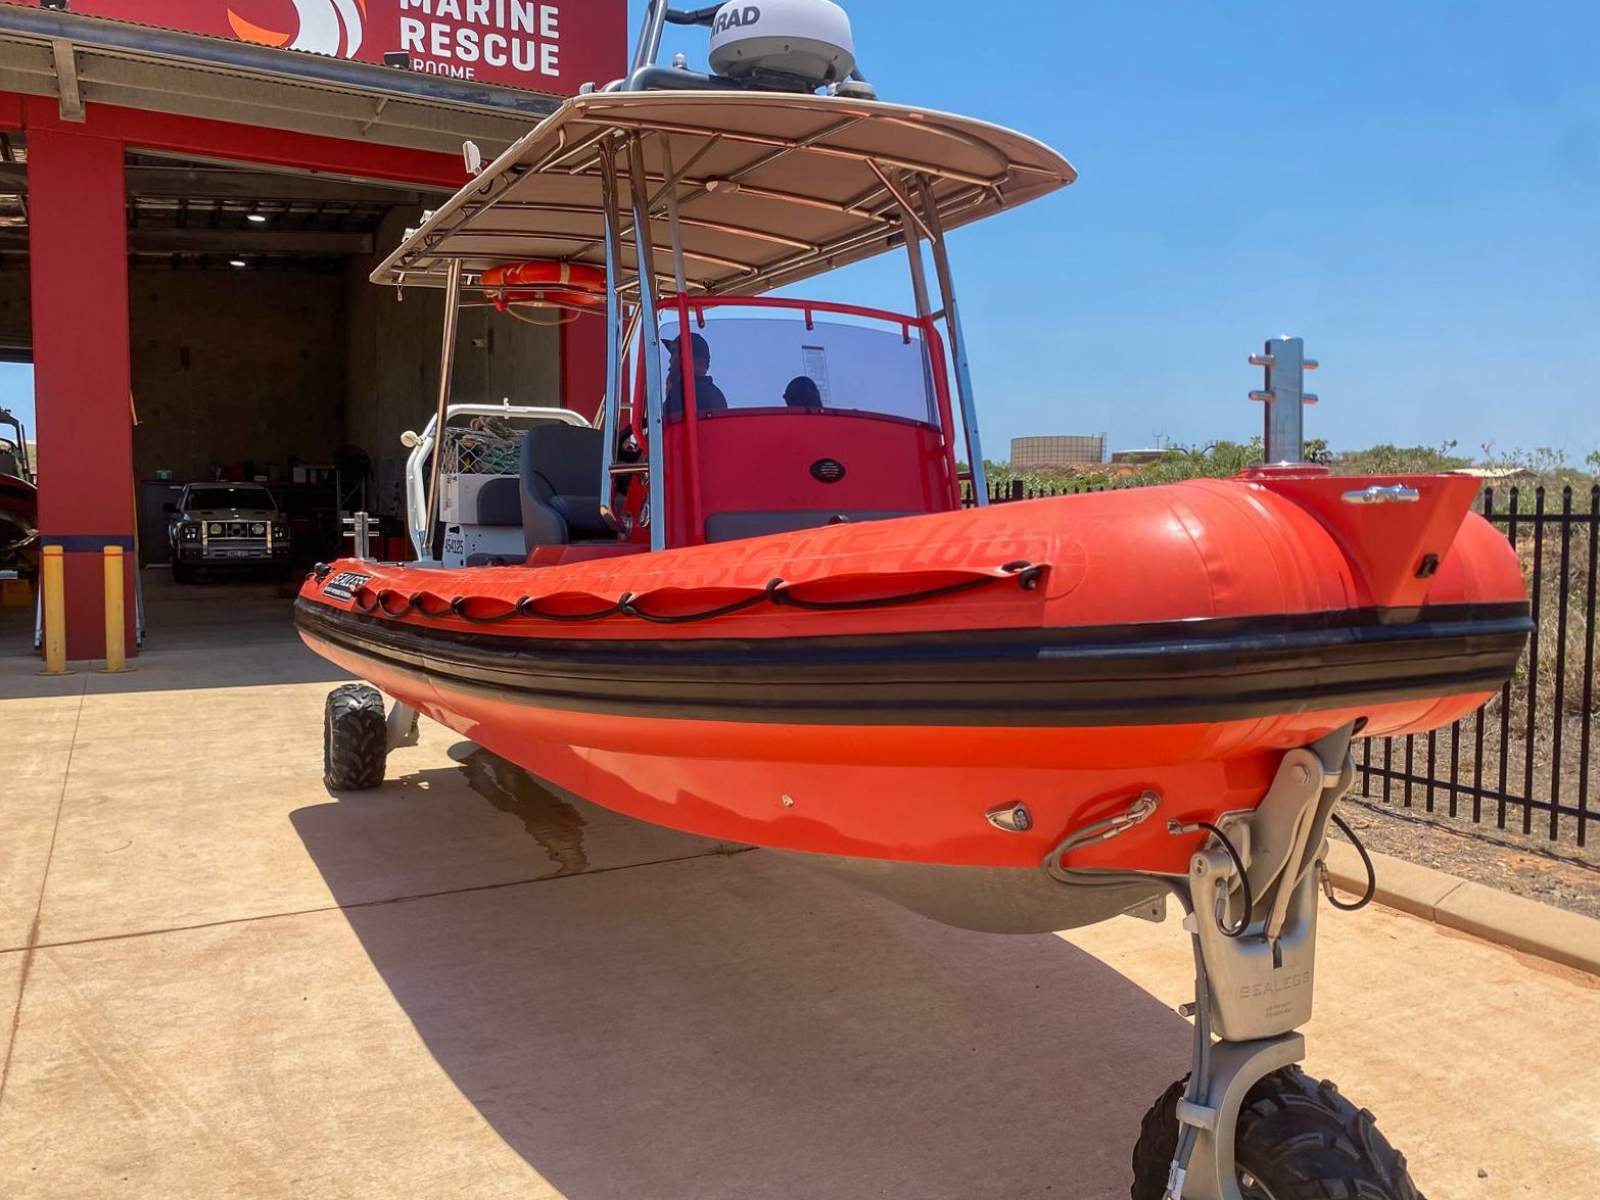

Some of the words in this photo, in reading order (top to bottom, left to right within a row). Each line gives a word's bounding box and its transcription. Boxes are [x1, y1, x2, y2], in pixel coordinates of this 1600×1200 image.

[712, 6, 760, 35] RAD
[400, 16, 560, 77] RESCUE
[411, 58, 475, 80] ROOME
